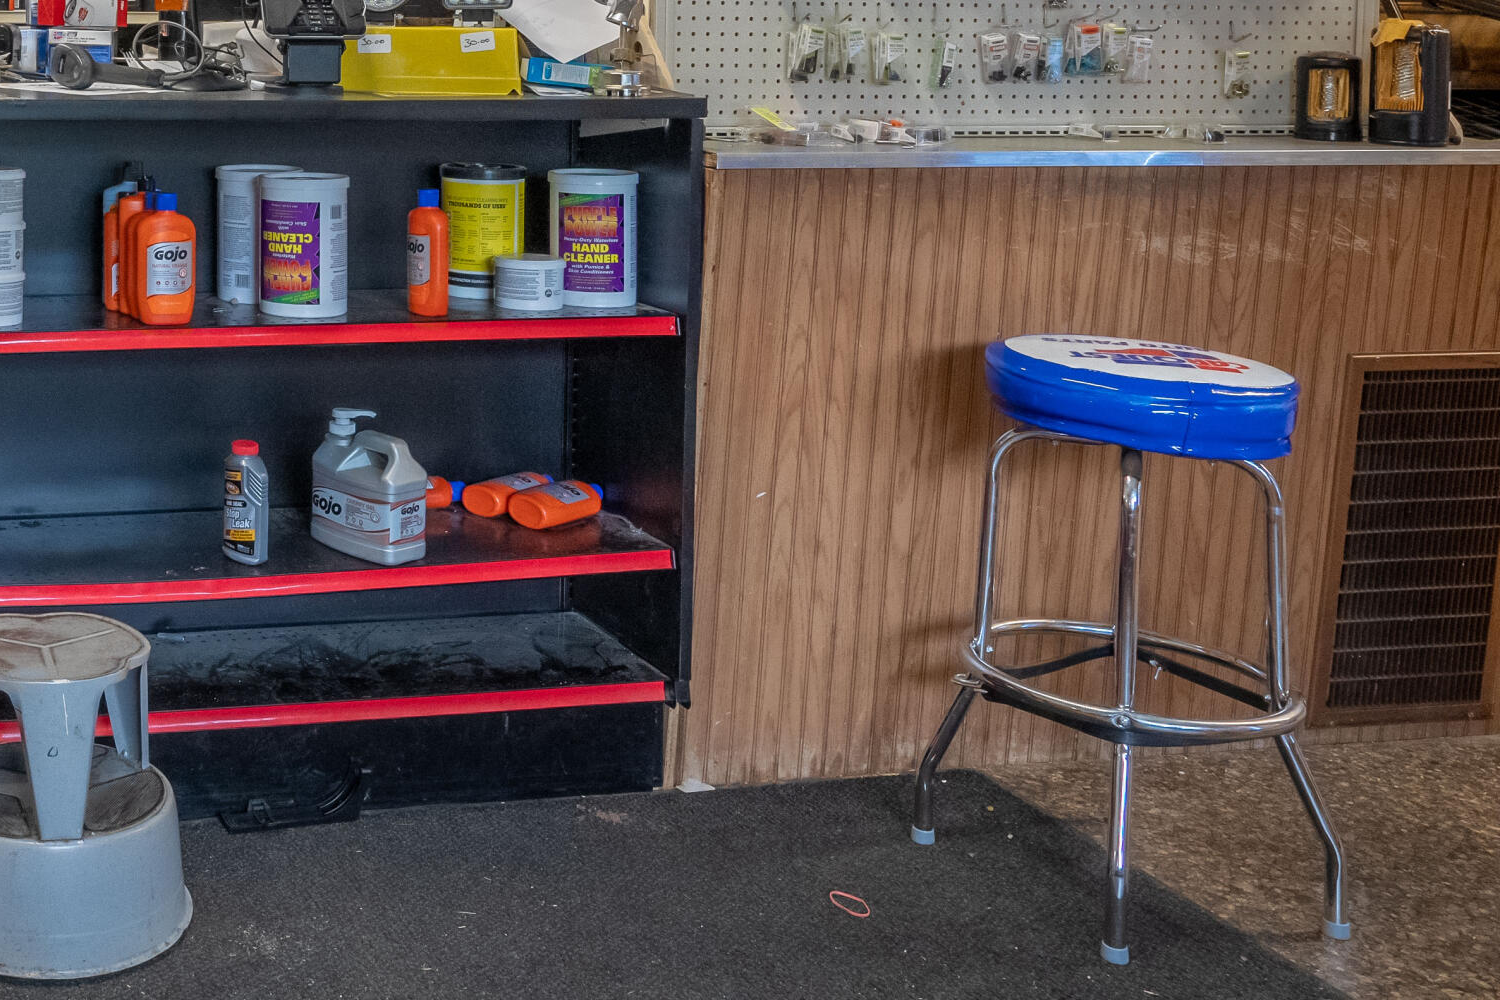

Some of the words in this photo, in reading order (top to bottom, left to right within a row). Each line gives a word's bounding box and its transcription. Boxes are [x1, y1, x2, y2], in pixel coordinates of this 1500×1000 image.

[463, 37, 491, 49] 30.00
[448, 200, 482, 209] THOUSANDS
[563, 205, 618, 222] PURPLE
[563, 220, 618, 238] POWER
[263, 230, 313, 244] CLEANER
[268, 242, 303, 254] HAND
[572, 242, 610, 254] HAND
[563, 252, 619, 264] CLEANER
[226, 508, 240, 520] Stop
[231, 518, 252, 529] Leak
